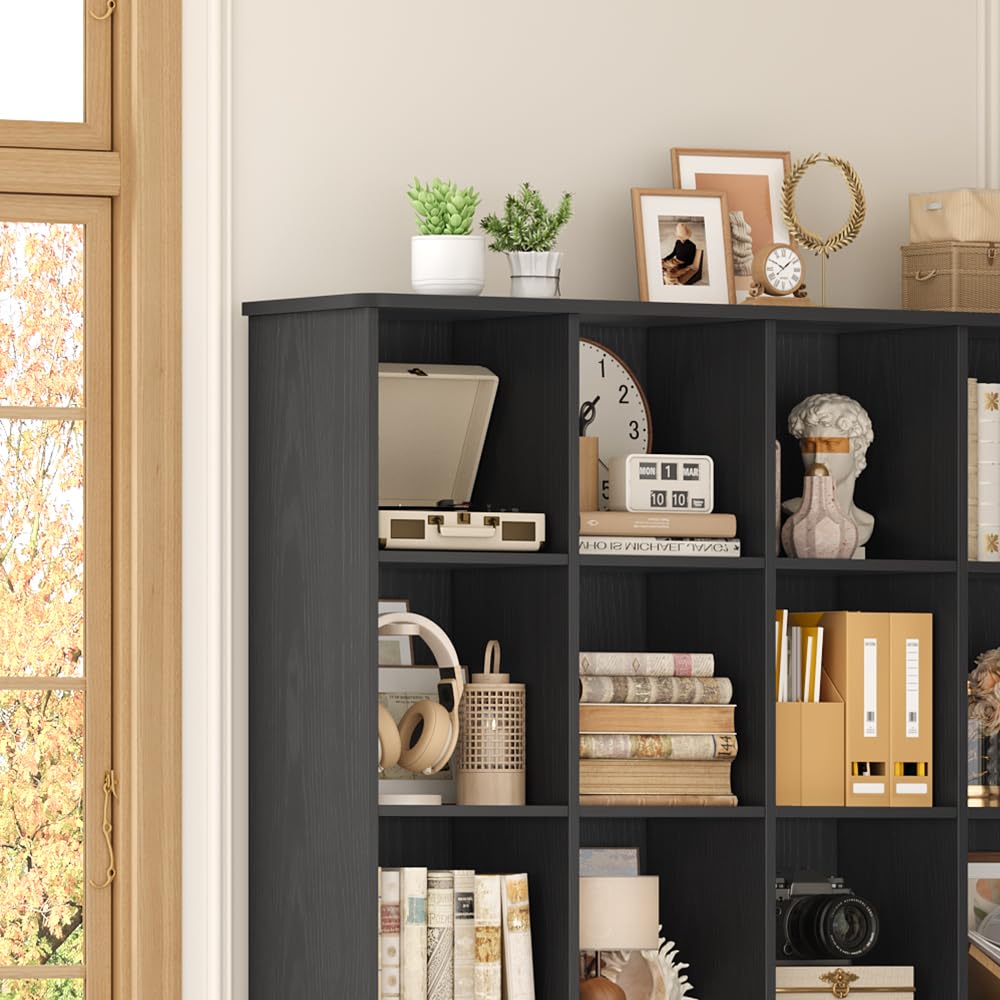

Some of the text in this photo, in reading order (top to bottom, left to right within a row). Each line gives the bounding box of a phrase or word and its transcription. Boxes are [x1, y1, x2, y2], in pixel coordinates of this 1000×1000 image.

[598, 359, 605, 378] 1
[619, 384, 630, 404] 2
[629, 420, 640, 440] 3
[640, 466, 656, 476] MON
[665, 464, 671, 479] 1
[651, 492, 664, 506] 10
[672, 493, 686, 506] 10
